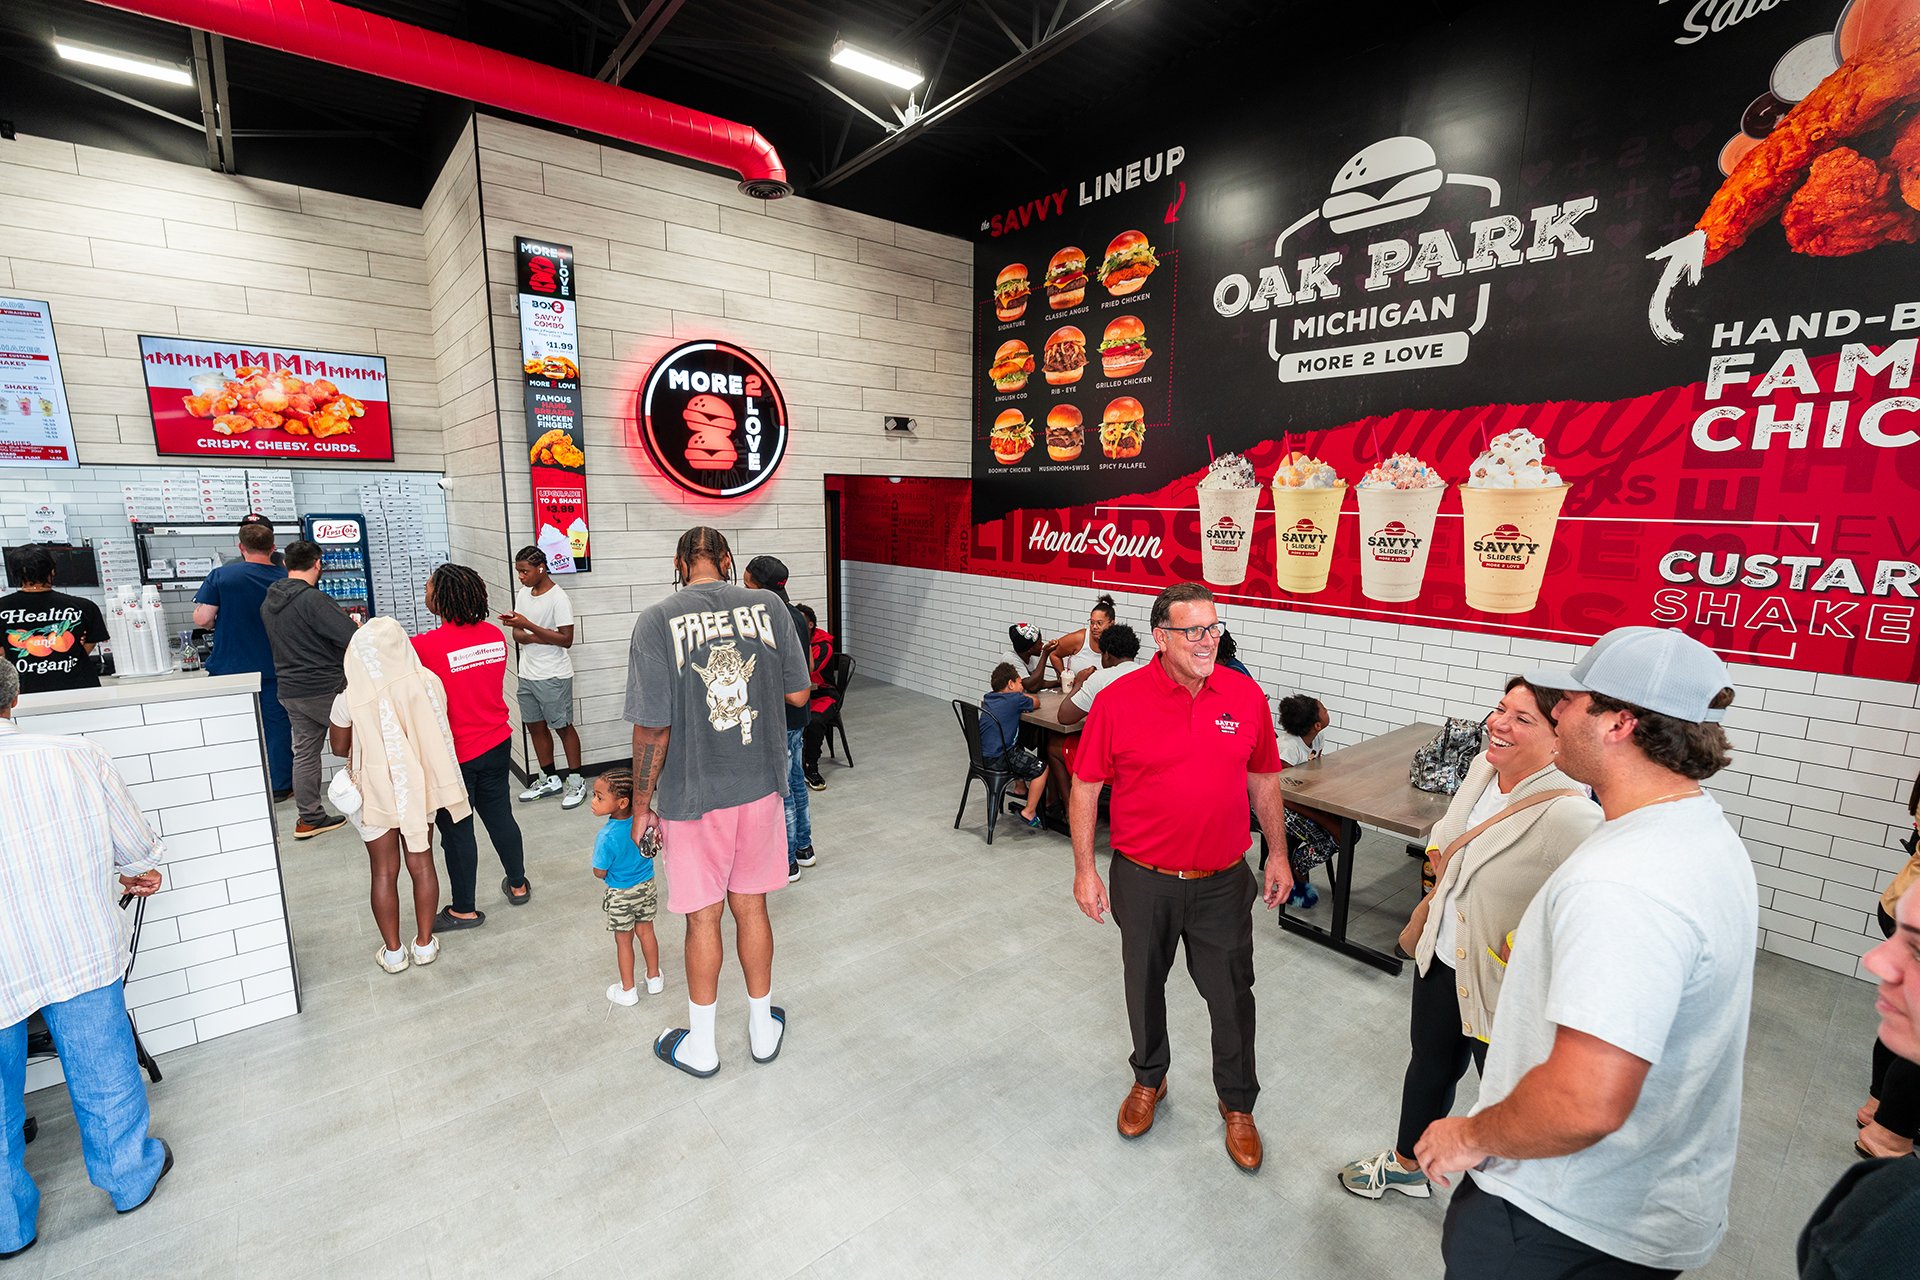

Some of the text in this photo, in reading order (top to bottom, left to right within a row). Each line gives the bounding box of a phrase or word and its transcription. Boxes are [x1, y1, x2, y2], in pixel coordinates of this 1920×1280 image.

[980, 145, 1185, 238] the SAVVY LINEUP
[521, 242, 557, 258] MORE
[1213, 196, 1598, 318] OAK PARK
[559, 258, 569, 296] LOVE
[553, 301, 562, 312] 2
[1101, 292, 1151, 309] FRIED CHICKEN
[535, 313, 563, 322] SAVVY
[1045, 306, 1090, 321] CLASSIC ANGUS
[1292, 294, 1456, 341] MICHIGAN
[534, 320, 564, 330] COMBO
[998, 320, 1026, 331] SIGNATURE
[546, 341, 573, 351] $11.99
[1297, 342, 1444, 373] MORE 2 LOVE
[1704, 338, 1919, 401] FAM
[558, 382, 576, 390] LOVE
[668, 368, 762, 397] MORE 2
[1095, 376, 1152, 390] GRILLED CHICKEN
[995, 394, 1015, 402] ENGLISH
[1051, 387, 1061, 395] RIB
[535, 394, 572, 403] FAMOUS
[536, 414, 573, 423] CHICKEN
[537, 421, 573, 430] FINGERS
[1691, 396, 1920, 452] CHIC
[745, 397, 762, 471] LOVE
[197, 438, 361, 454] CRISPY. CHEESY. CURDS.
[1038, 464, 1090, 472] MUSHROOM+SWISS
[546, 505, 575, 513] $3.99
[1206, 530, 1246, 539] SAVVY
[1281, 533, 1328, 544] SAVVY
[1028, 520, 1163, 565] Hand-Spun
[1367, 536, 1423, 549] SAVVY
[1473, 541, 1540, 555] SAVVY
[1486, 554, 1522, 562] SLIDERS
[1658, 550, 1920, 598] CUSTAR
[0, 607, 82, 624] Healthy
[1651, 588, 1915, 644] SHAKE
[32, 636, 57, 648] and
[669, 604, 777, 670] FREE BG
[16, 656, 78, 674] Organic
[1215, 719, 1240, 728] SAVVY
